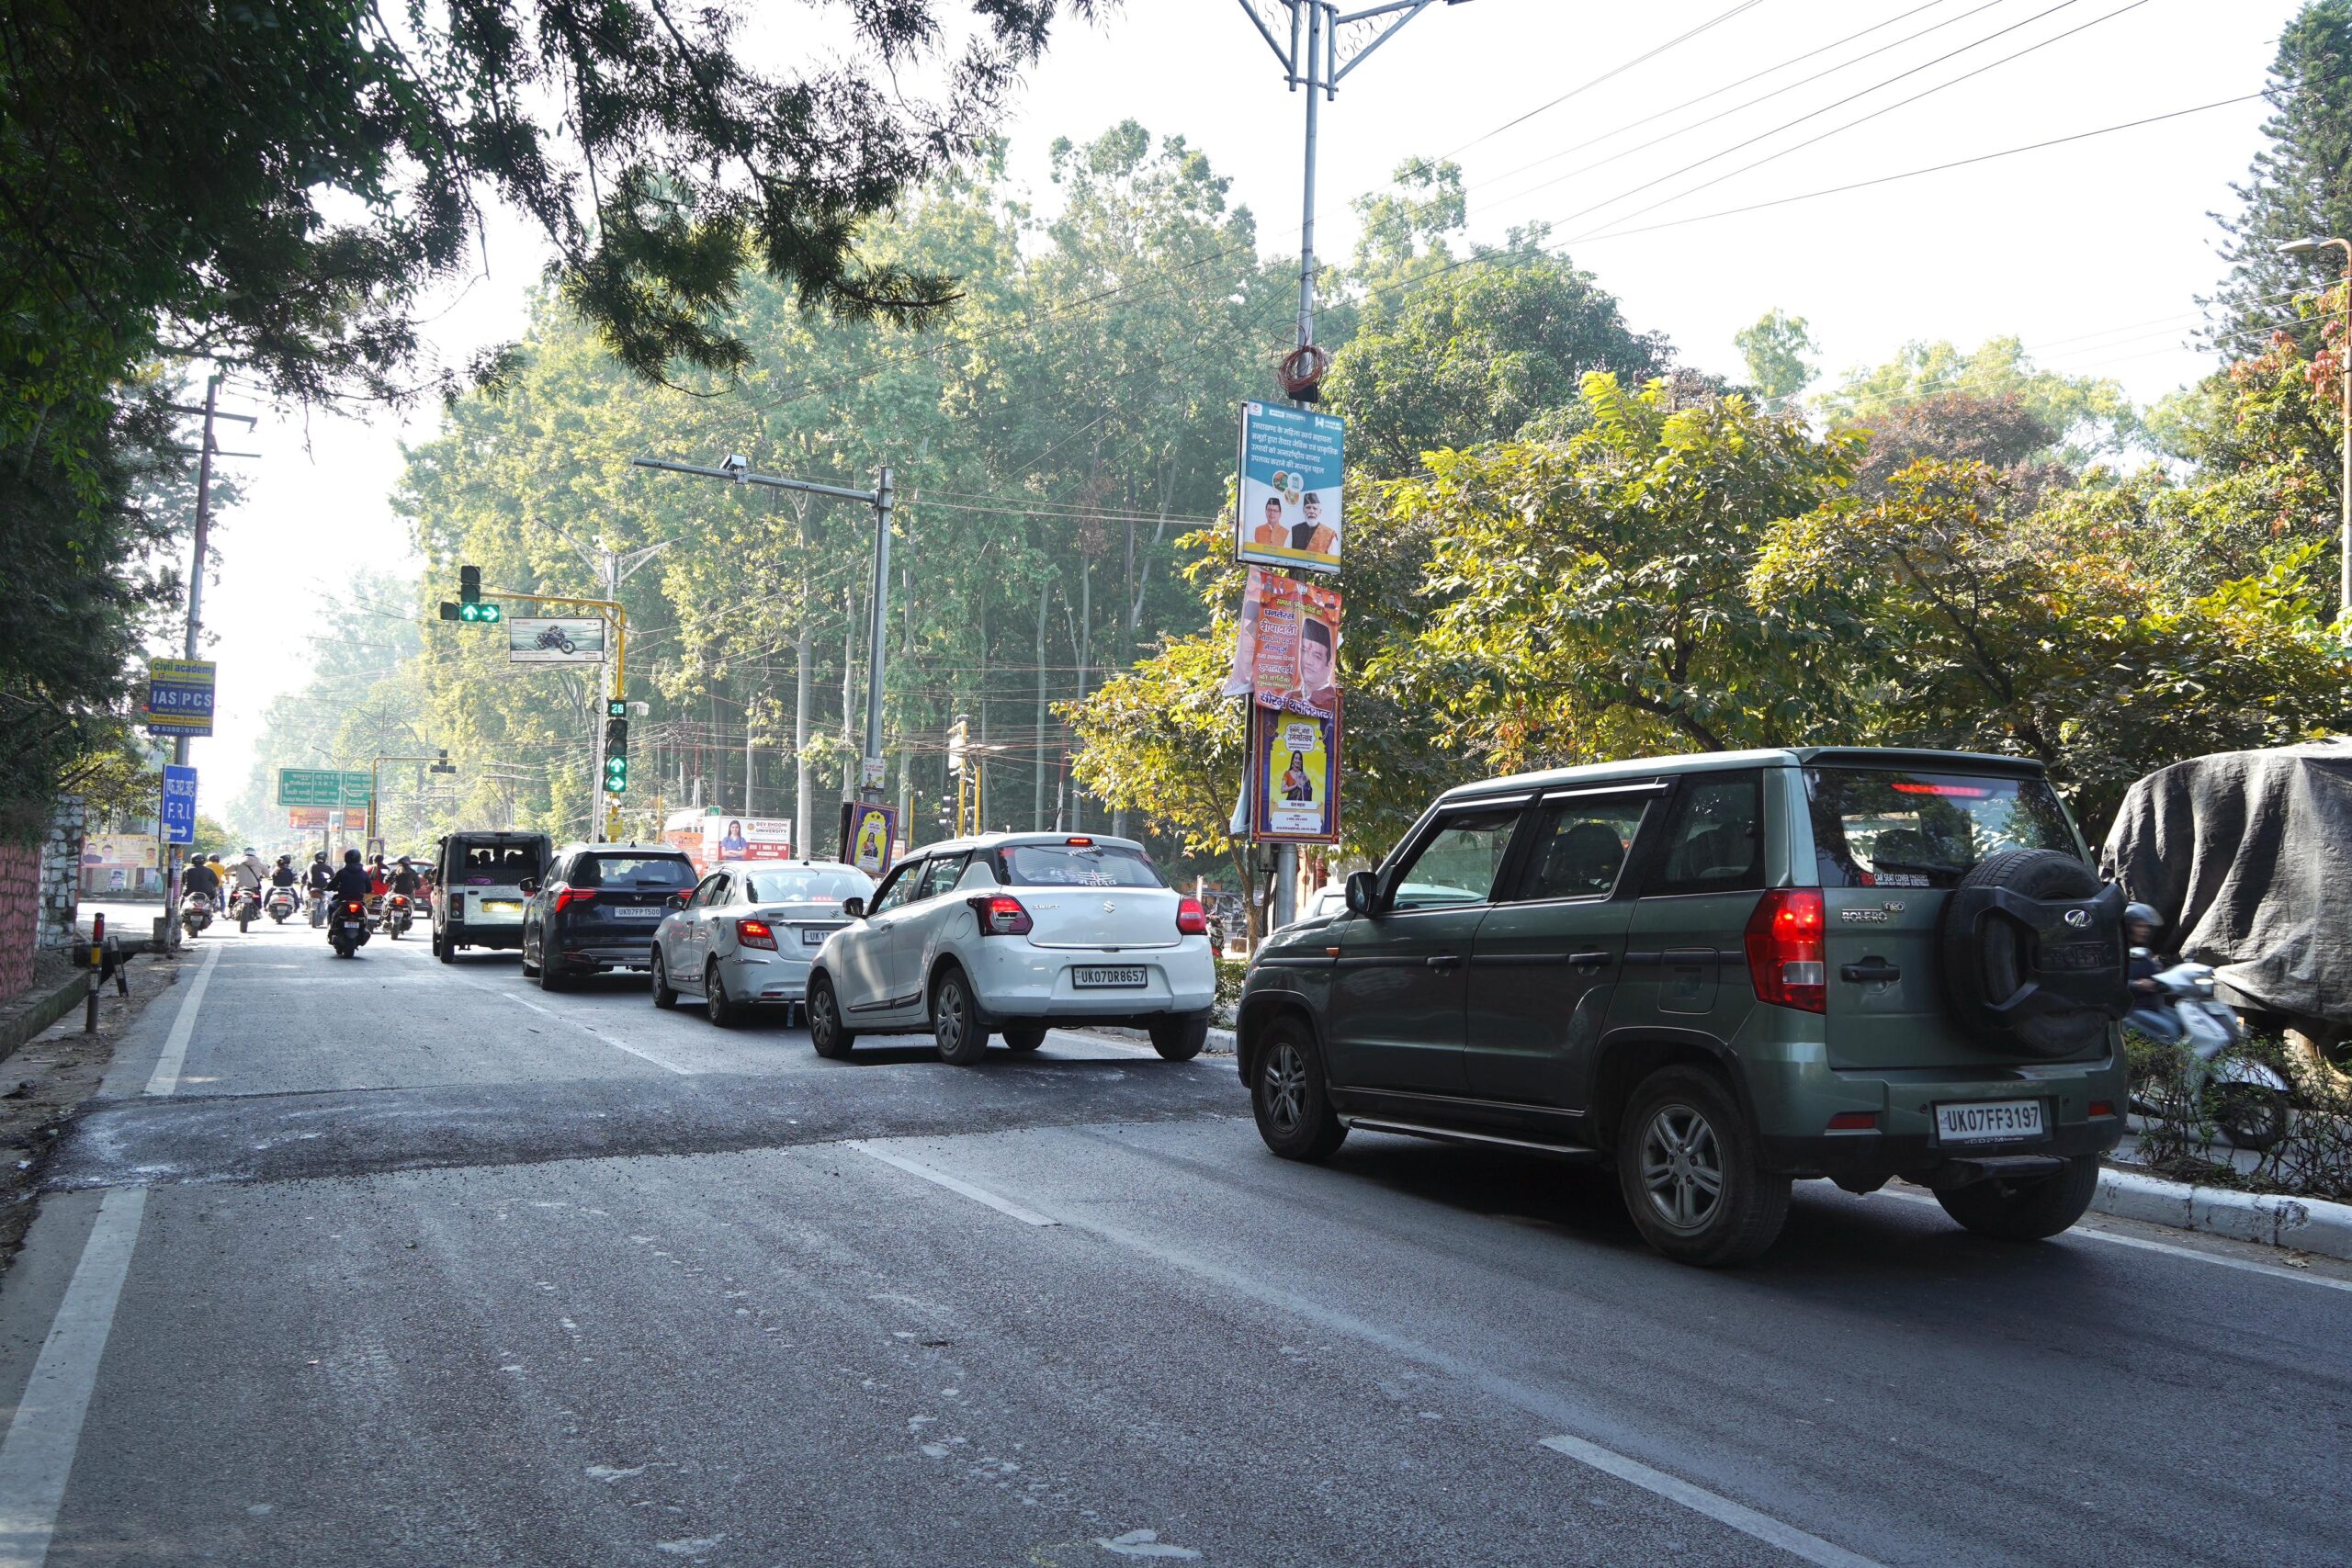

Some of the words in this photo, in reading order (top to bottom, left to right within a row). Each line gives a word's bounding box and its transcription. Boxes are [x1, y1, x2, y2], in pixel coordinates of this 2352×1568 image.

[1259, 619, 1298, 635] दीपावली
[154, 661, 173, 671] civil
[175, 663, 213, 676] academy
[153, 691, 177, 705] IAS
[182, 693, 212, 706] PCS
[1883, 874, 1894, 882] SEAT
[1894, 874, 1909, 882] COVER
[1884, 902, 1905, 911] neo
[1841, 909, 1888, 924] BOLERO
[1081, 970, 1145, 984] UK07DR8657
[1948, 1106, 2038, 1132] UK07FF3197
